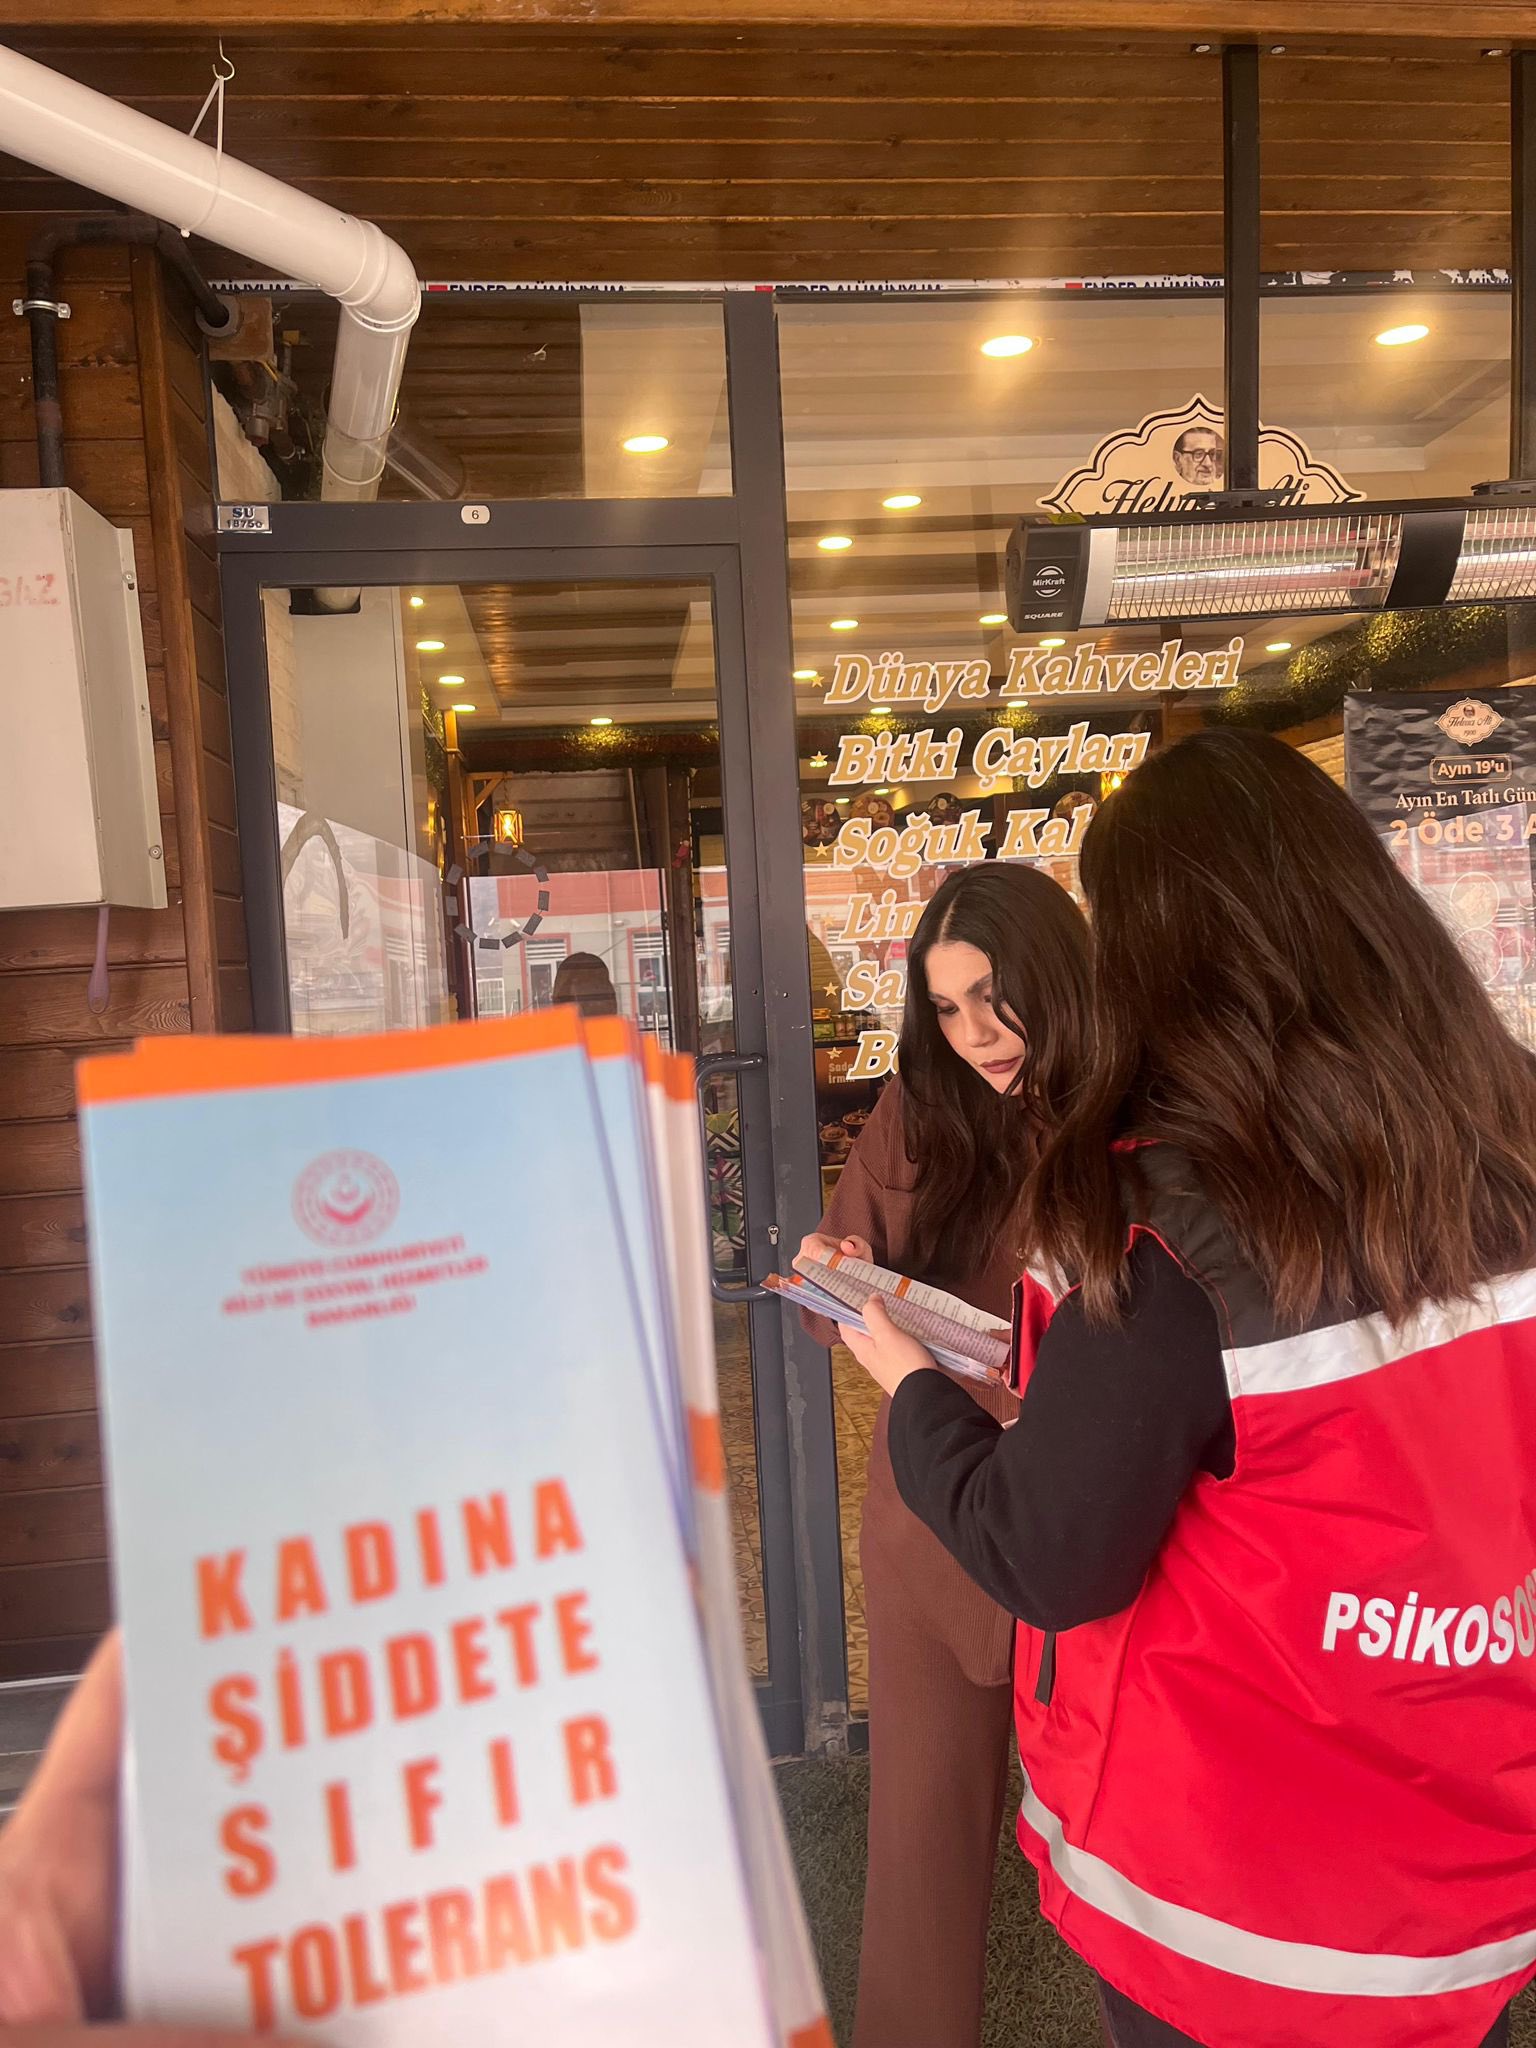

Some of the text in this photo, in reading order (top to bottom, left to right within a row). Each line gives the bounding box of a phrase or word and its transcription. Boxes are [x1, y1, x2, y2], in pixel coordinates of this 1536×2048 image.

[232, 507, 255, 519] SU
[471, 509, 480, 520] 6
[1032, 578, 1066, 587] MirKraft
[1024, 612, 1064, 620] SQUARE
[825, 636, 1246, 714] Dünya Kahveleri
[828, 721, 1152, 791] Bitki Çayları
[1437, 762, 1472, 779] Ayın
[1395, 792, 1433, 811] Ayın
[1436, 791, 1459, 807] En
[1461, 788, 1501, 805] Tatlı
[833, 809, 993, 880] Soğuk
[1389, 819, 1410, 846] 2
[1417, 810, 1485, 845] Öde
[1495, 814, 1515, 841] 3
[193, 1476, 586, 1642] KADINA
[206, 1589, 602, 1787] ŞİDDETE
[217, 1713, 620, 1901] SIFIR
[229, 1842, 640, 2037] TOLERANS
